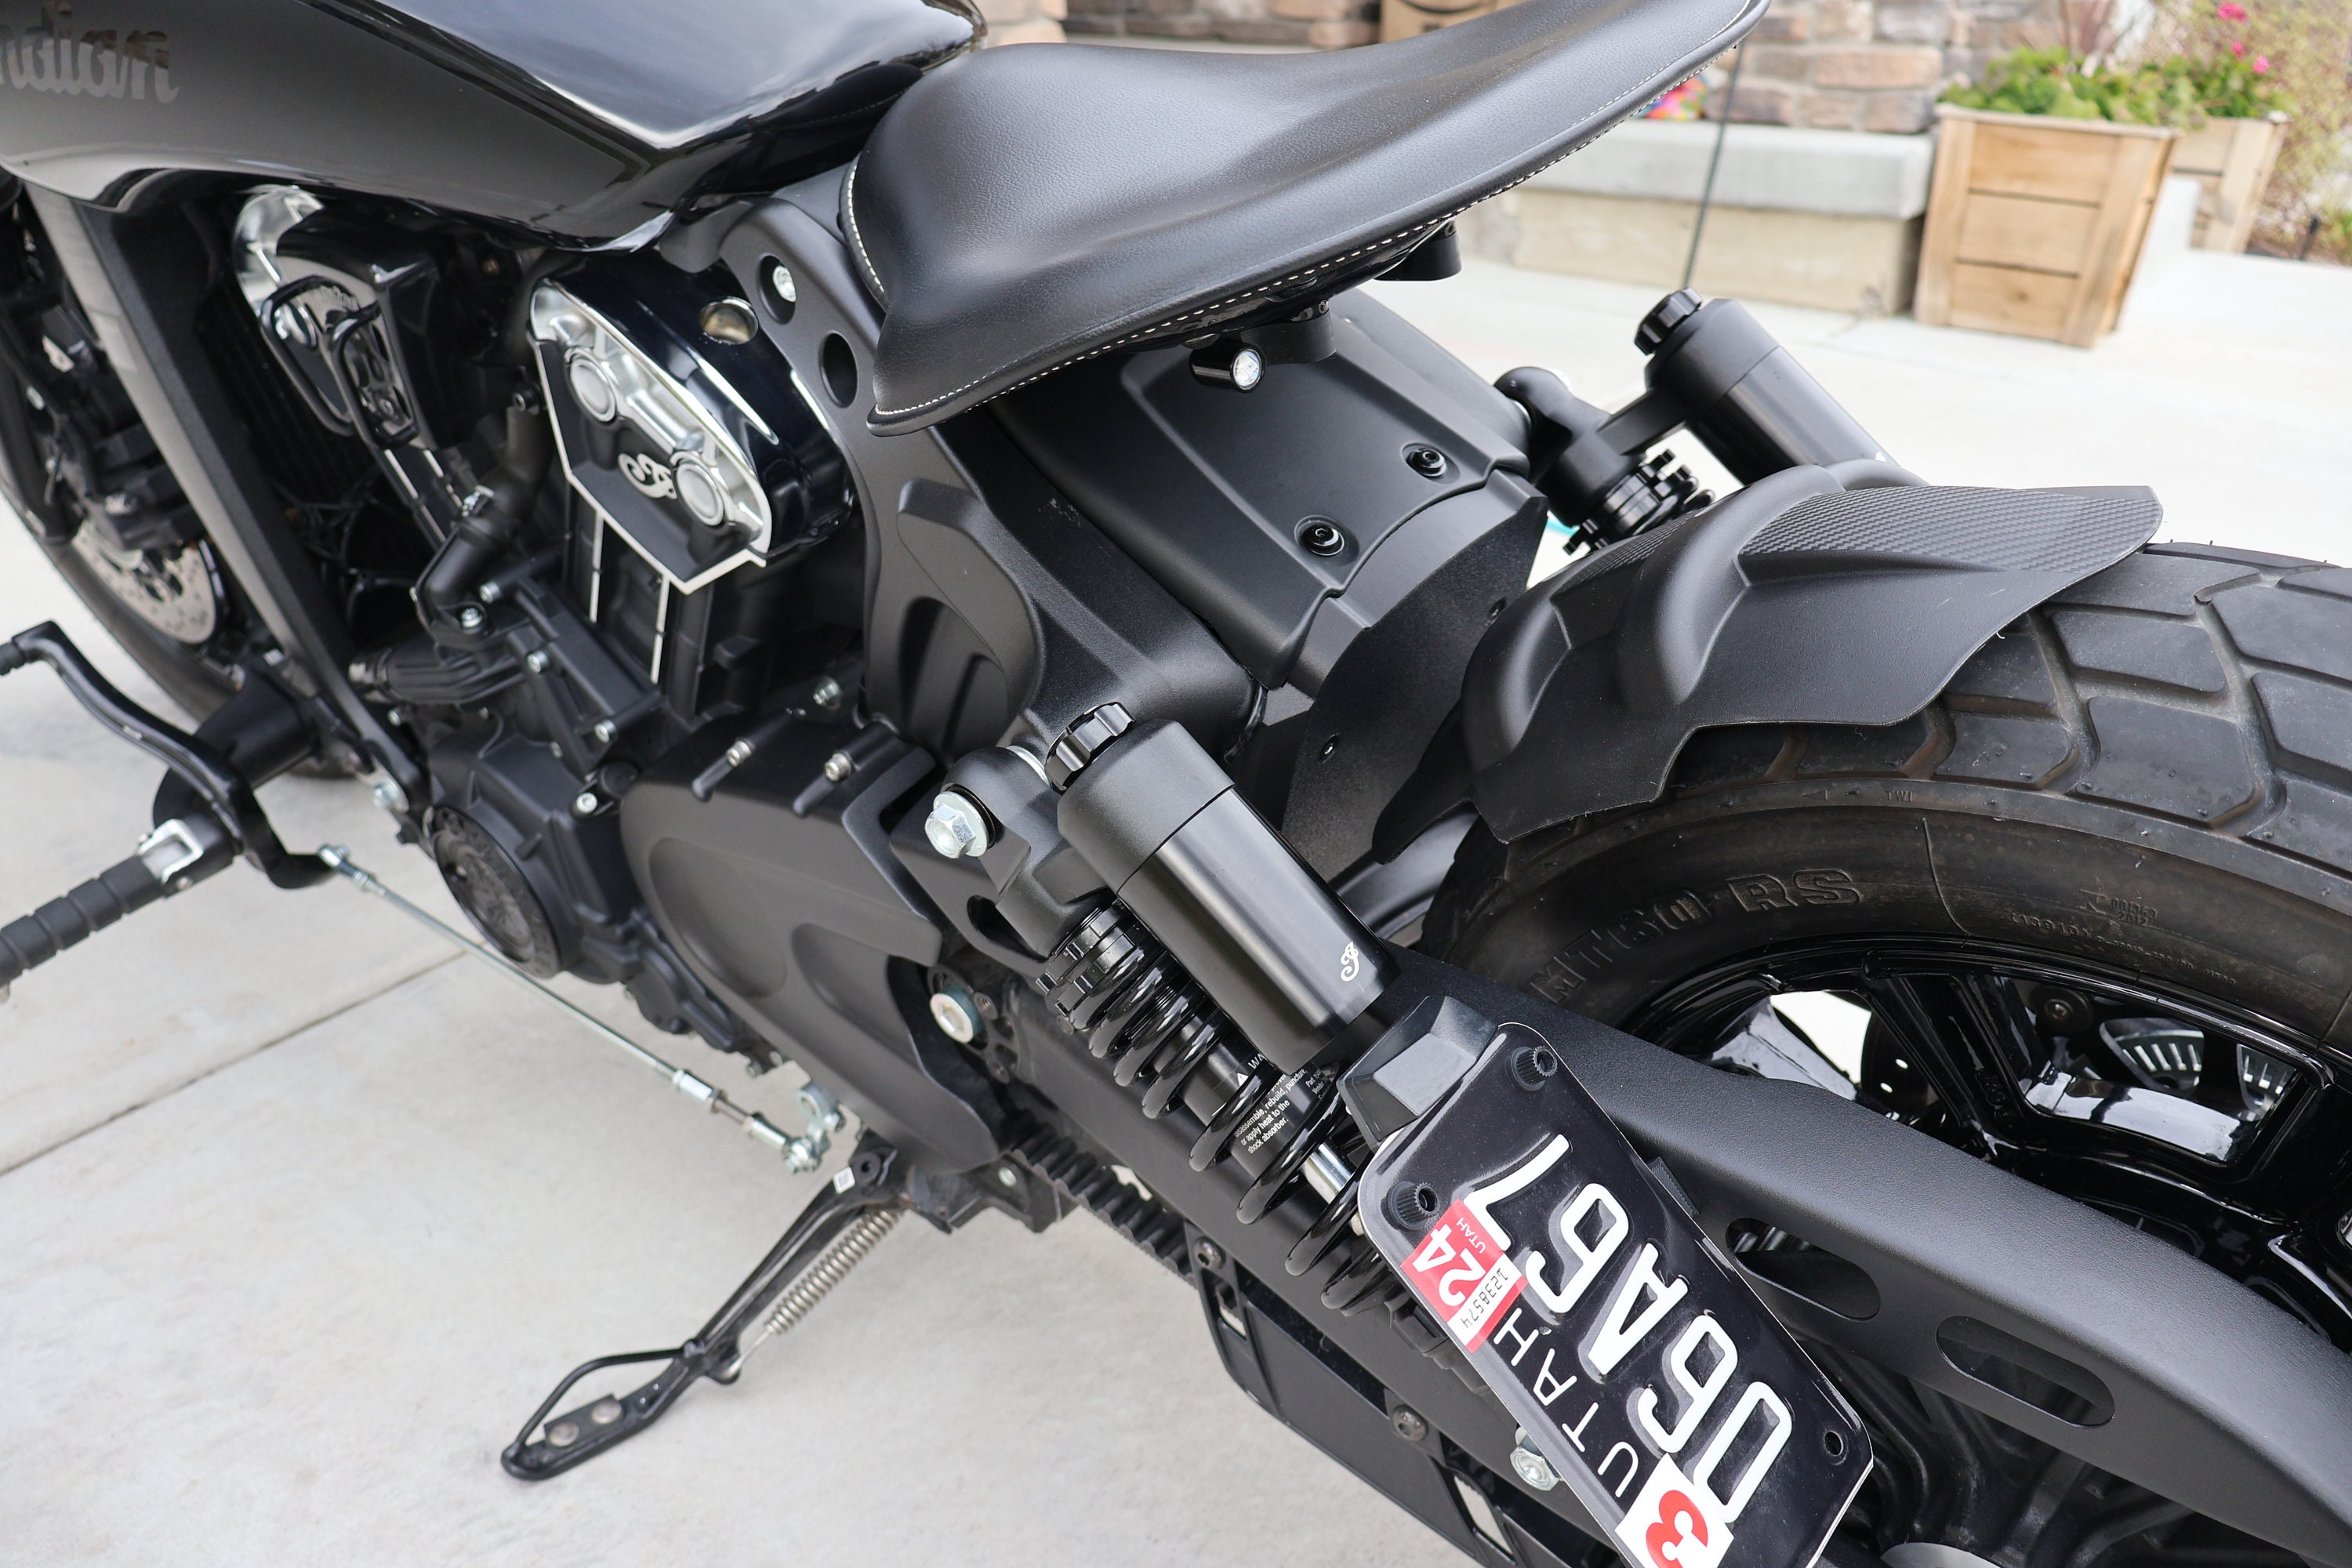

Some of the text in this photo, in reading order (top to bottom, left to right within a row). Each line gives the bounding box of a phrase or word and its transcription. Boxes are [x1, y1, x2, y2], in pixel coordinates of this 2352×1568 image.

[0, 1, 180, 103] ndian
[1886, 789, 1913, 802] TWI
[1726, 868, 1864, 912] RS
[1265, 1088, 1288, 1109] rebuild,
[1286, 1069, 1308, 1091] puncture,
[1246, 1127, 1261, 1142] apply
[1258, 1115, 1274, 1130] heat
[1272, 1109, 1280, 1118] to
[1279, 1099, 1290, 1111] the
[1247, 1116, 1290, 1154] shock absorber.
[1457, 1218, 1486, 1254] UTAH
[1412, 1223, 1486, 1306] 24
[1461, 1268, 1508, 1329] 1238574
[1493, 1307, 1639, 1498] UTAH
[1646, 1490, 1708, 1568] 3
